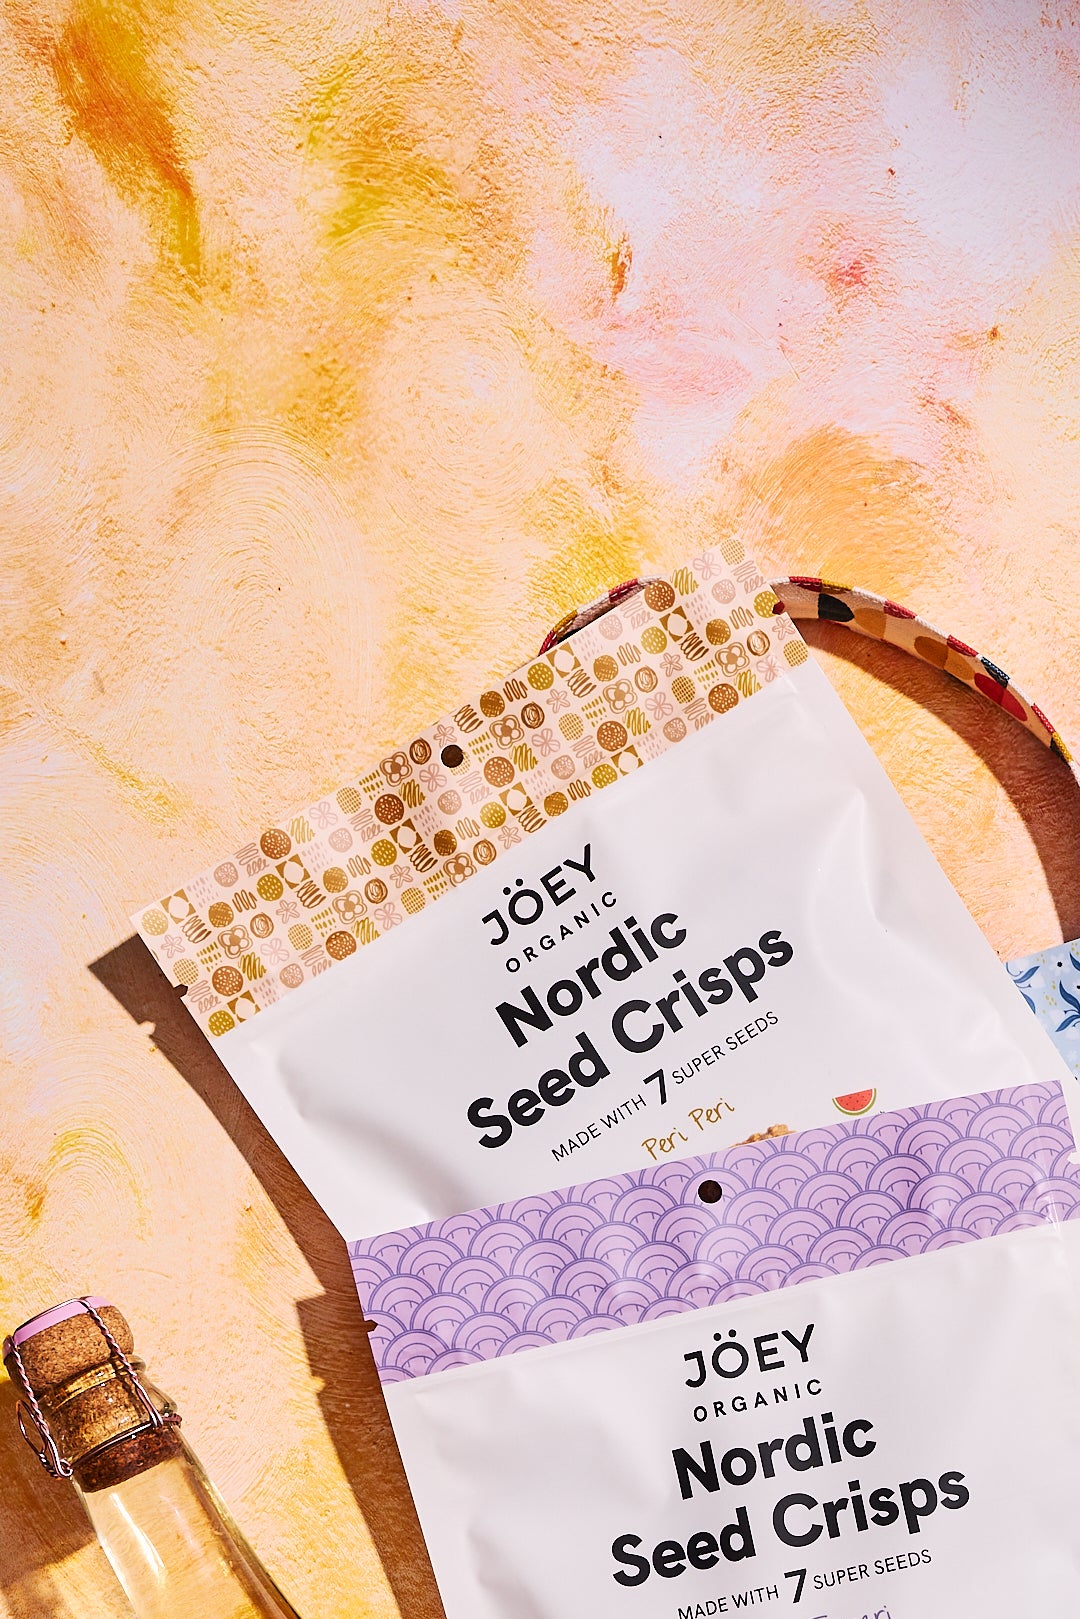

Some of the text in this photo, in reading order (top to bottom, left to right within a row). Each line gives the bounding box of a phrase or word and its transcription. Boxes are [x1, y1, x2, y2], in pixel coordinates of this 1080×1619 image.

[482, 844, 600, 946] JÖEY
[505, 892, 617, 973] ORGANIC
[495, 913, 687, 1048] Nordic
[467, 930, 794, 1148] Seed Crisps
[551, 1011, 779, 1162] MADE WITH 7 SUPER SEEDS
[641, 1098, 735, 1161] Peri Peri
[683, 1324, 815, 1388] JÖEY
[693, 1379, 822, 1422] ORGANIC
[672, 1412, 877, 1500] Nordic
[611, 1471, 970, 1587] Seed Crisps
[732, 1585, 779, 1609] WITH
[783, 1569, 808, 1604] 7
[813, 1564, 870, 1590] SUPER
[875, 1549, 932, 1575] SEEDS
